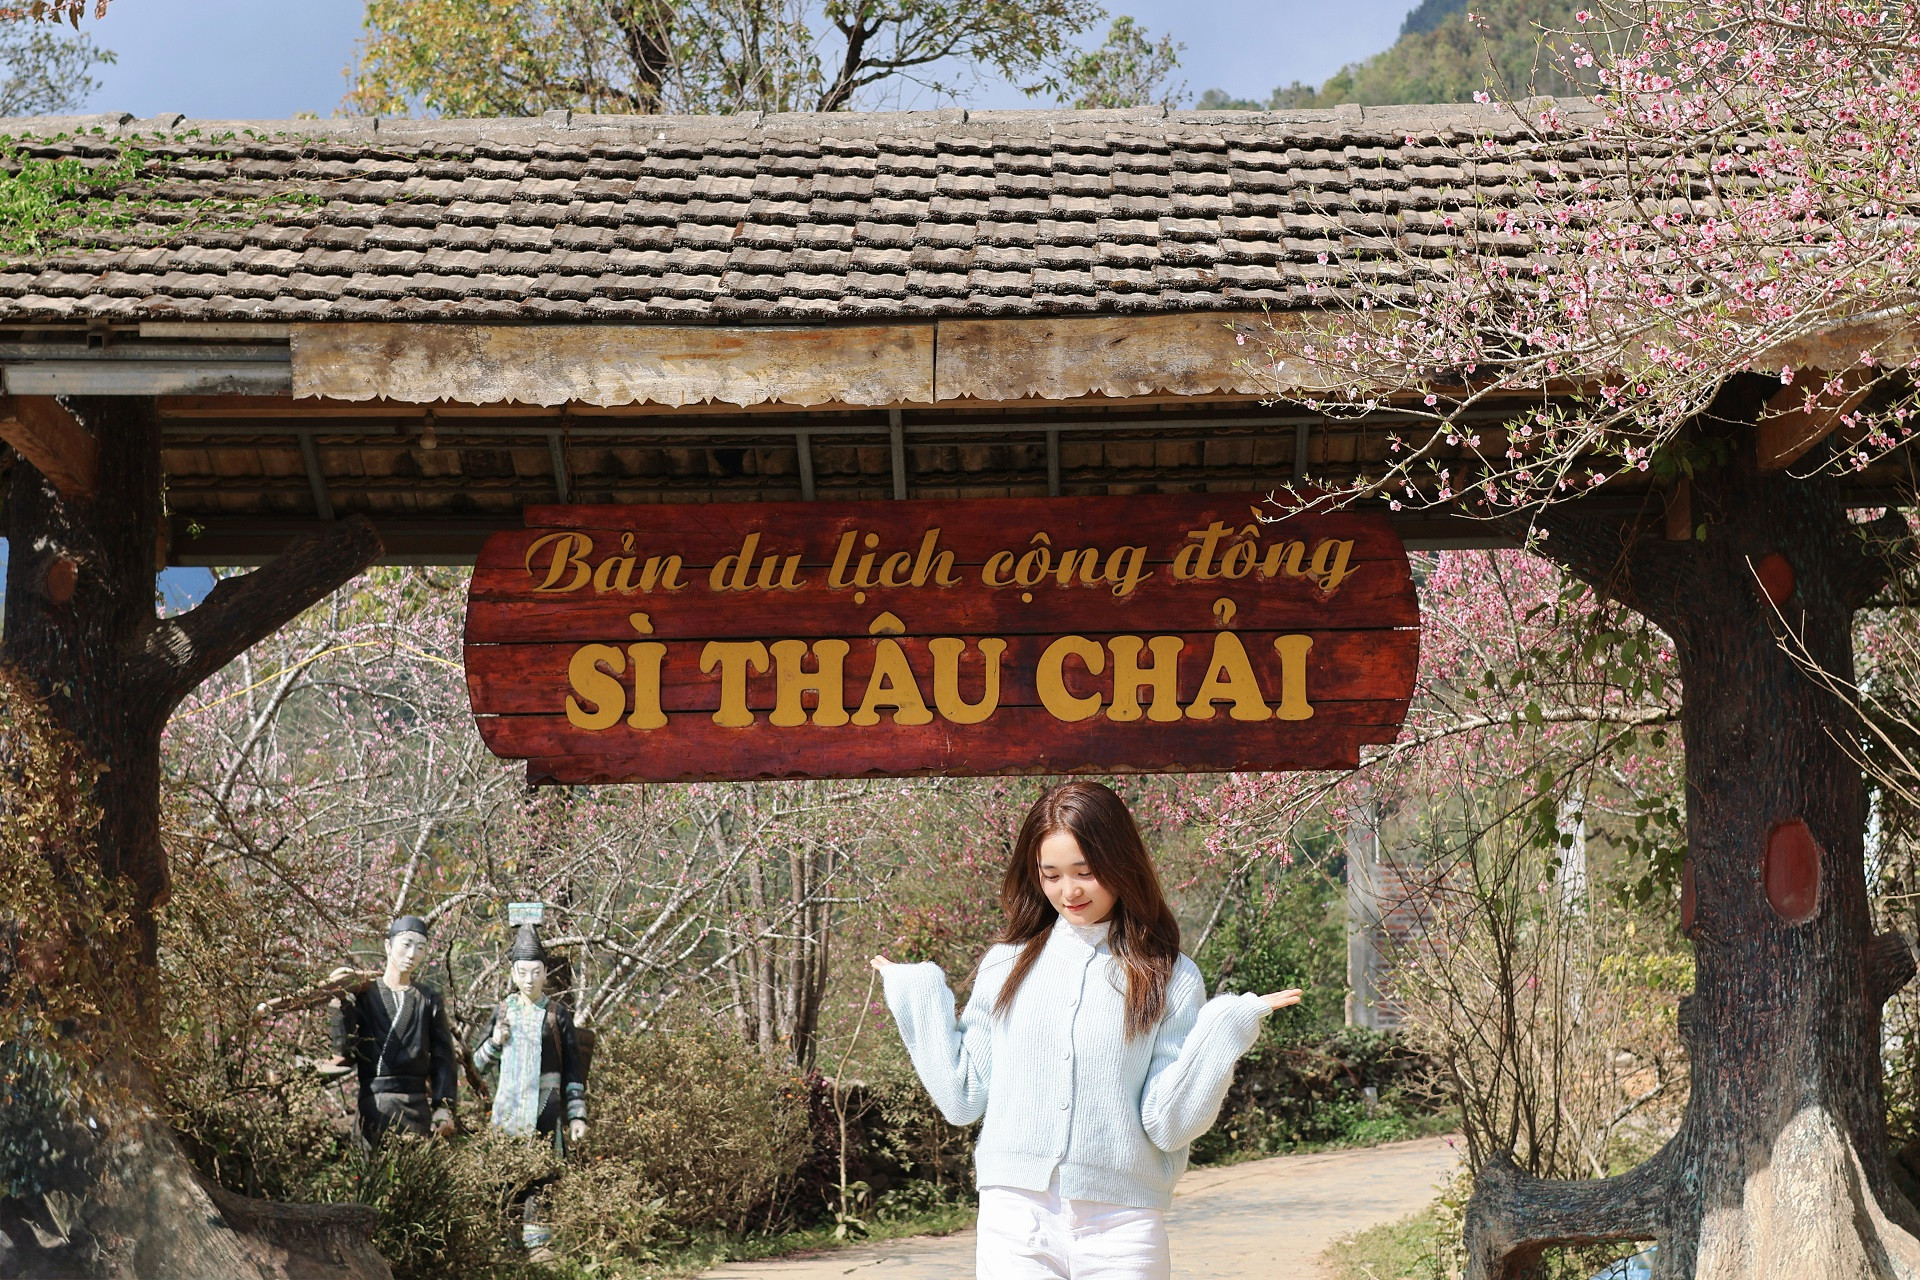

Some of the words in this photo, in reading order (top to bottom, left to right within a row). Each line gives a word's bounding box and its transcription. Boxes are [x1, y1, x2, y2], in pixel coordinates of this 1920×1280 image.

[525, 530, 689, 594] Bản
[708, 531, 808, 594] du
[827, 527, 963, 605] lịch
[981, 531, 1154, 604] cộng
[1173, 505, 1361, 591] đồng
[565, 612, 669, 731] SÌ
[699, 611, 1008, 729] THÂU
[1036, 597, 1315, 723] CHẢI
